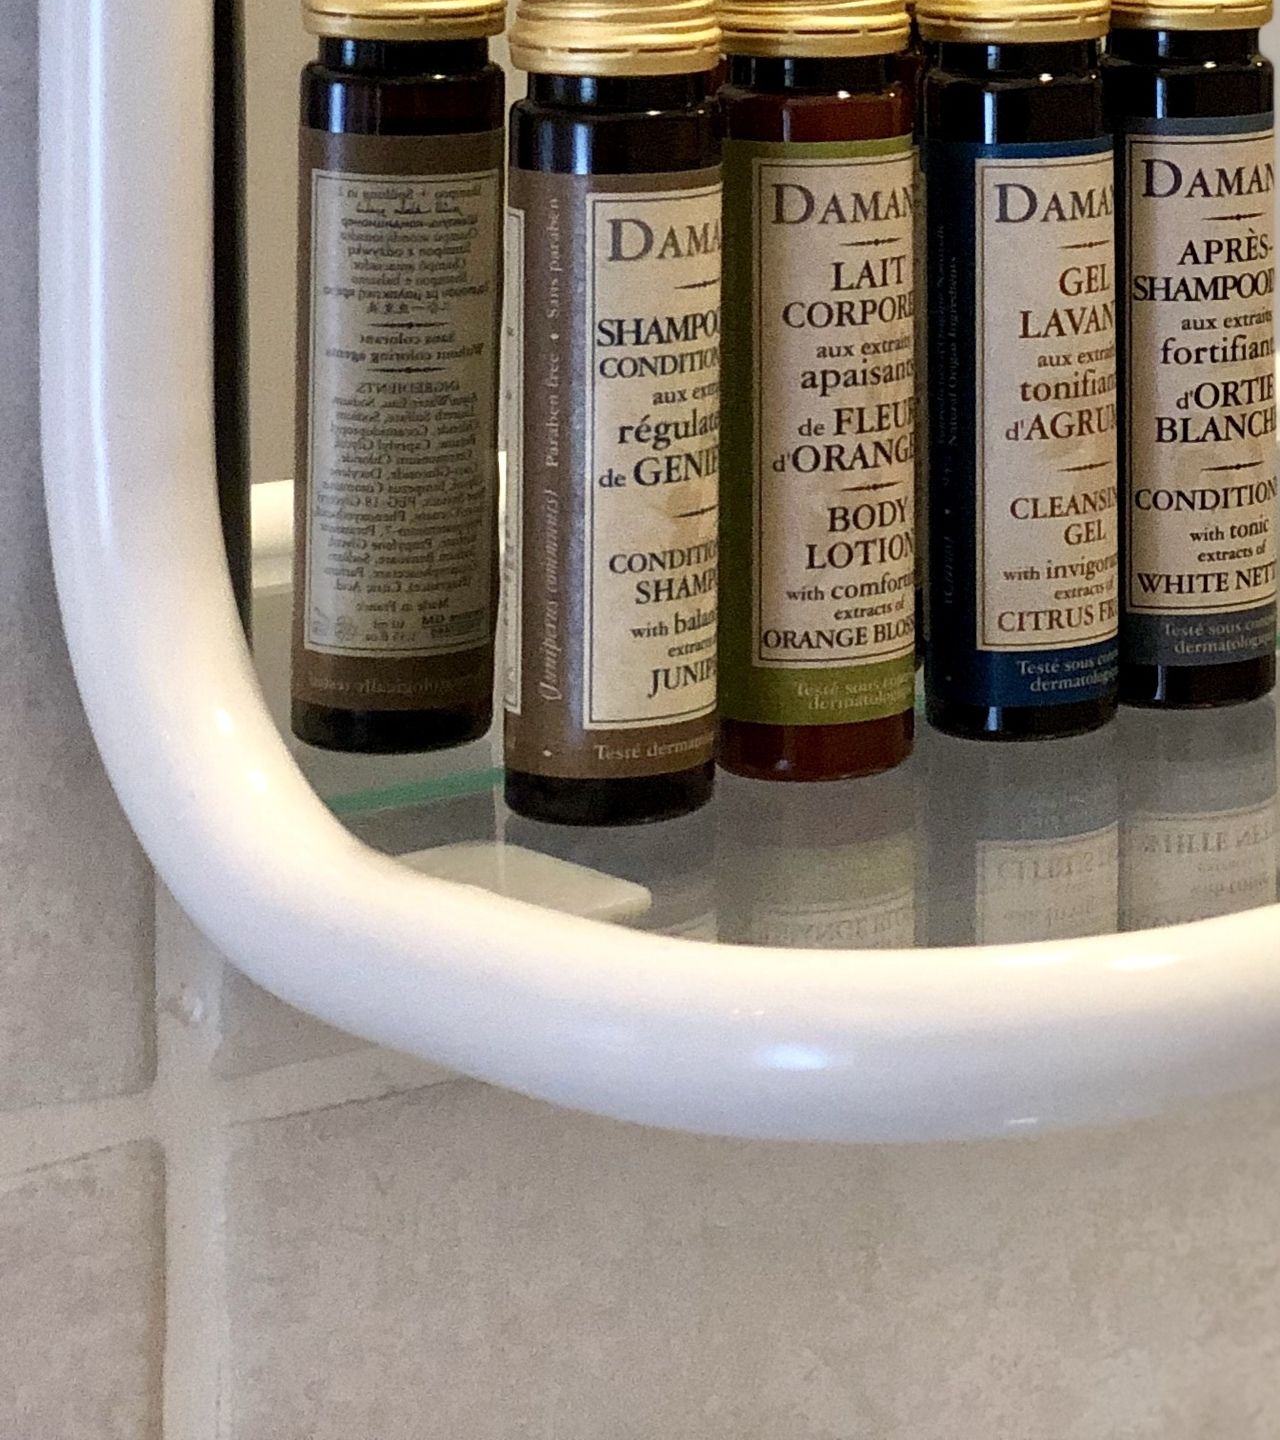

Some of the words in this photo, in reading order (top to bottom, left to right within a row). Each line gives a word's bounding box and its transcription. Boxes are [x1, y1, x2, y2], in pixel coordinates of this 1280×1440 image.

[993, 182, 1114, 223] DAMA
[545, 196, 563, 272] paraben
[1177, 227, 1273, 266] APRÈS-
[831, 254, 906, 291] LAIT
[1059, 263, 1110, 296] GEL
[545, 277, 560, 319] Sans
[1181, 315, 1217, 330] aux
[816, 342, 853, 359] aux
[1037, 352, 1072, 368] aux
[545, 353, 560, 388] free
[652, 389, 686, 405] aux
[545, 394, 560, 467] Paraben
[798, 417, 824, 437] de
[600, 468, 626, 488] de
[827, 495, 909, 533] BODY
[1064, 519, 1106, 546] GEL
[1189, 526, 1225, 542] with
[1230, 515, 1270, 540] tonic
[805, 528, 915, 571] LOTION
[1198, 545, 1253, 563] extracts
[1256, 539, 1266, 556] of
[1003, 566, 1040, 582] with
[1137, 571, 1229, 595] WHITE
[786, 585, 824, 602] with
[1054, 582, 1104, 601] extracts
[833, 602, 893, 621] extracts
[998, 604, 1093, 633] CITRUS
[630, 623, 669, 640] with
[763, 627, 868, 650] ORANGE
